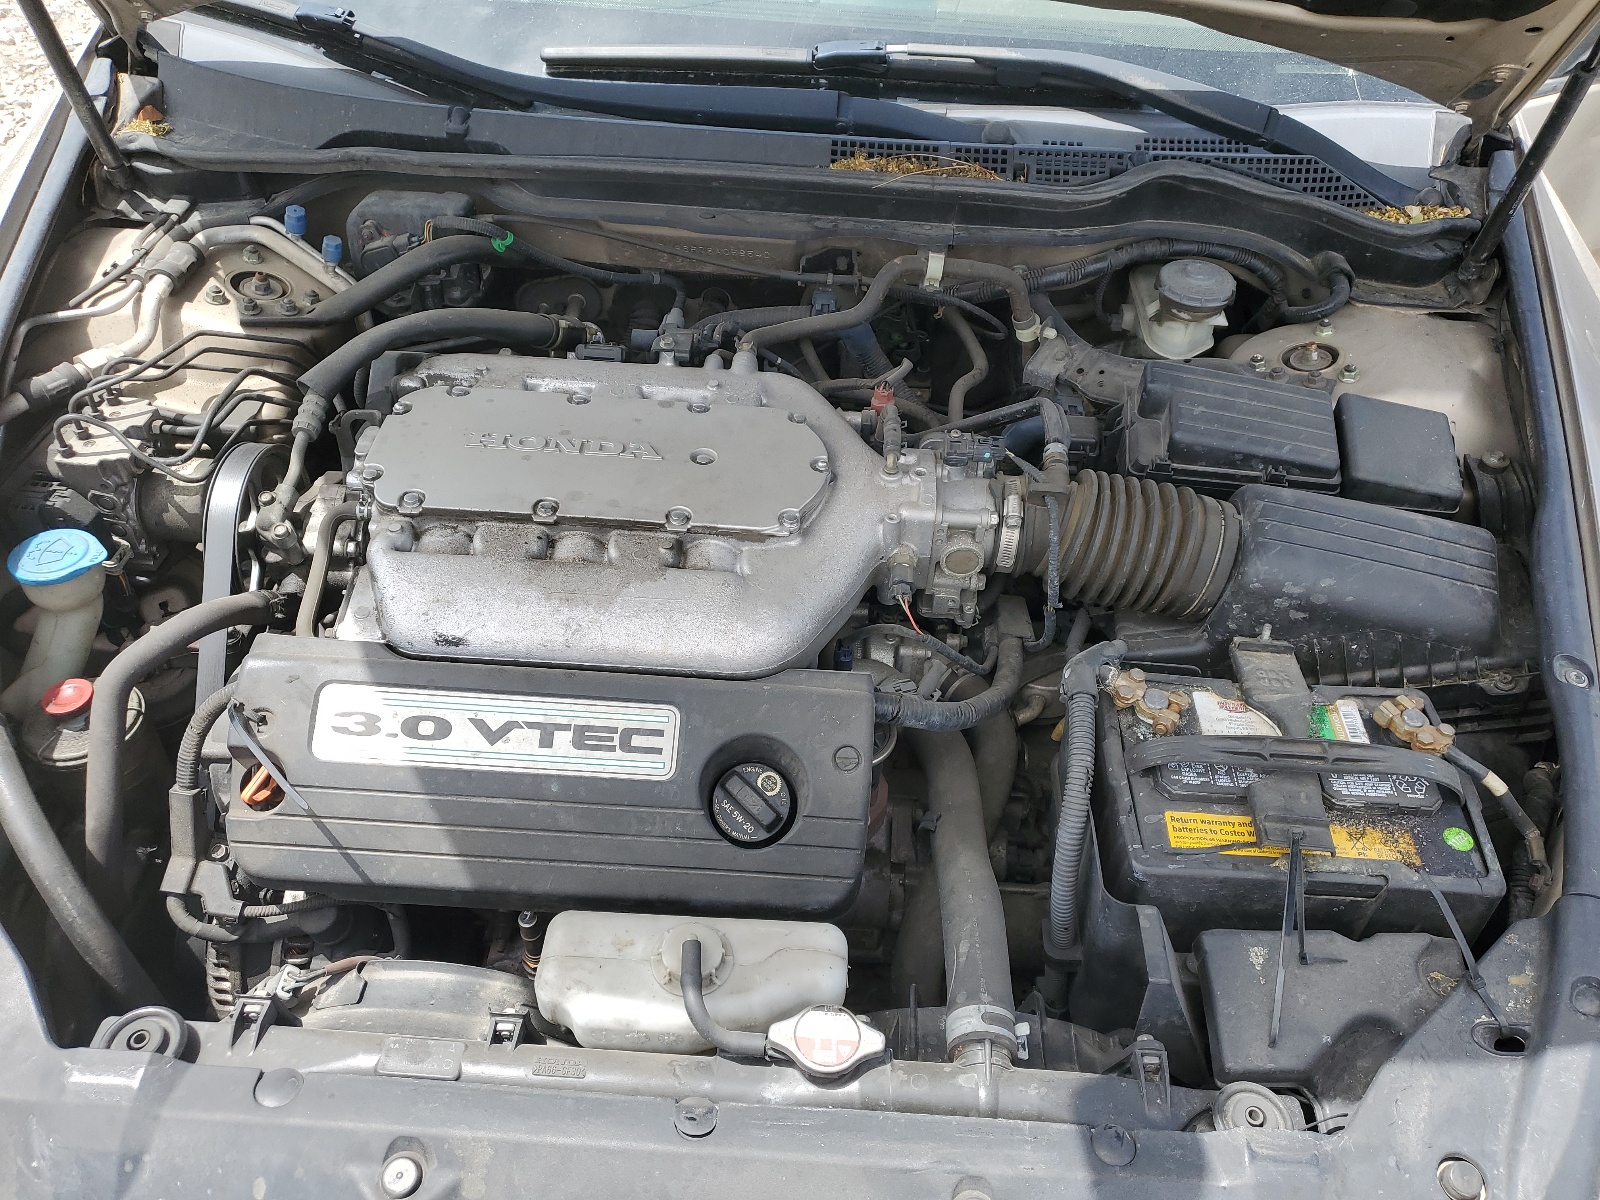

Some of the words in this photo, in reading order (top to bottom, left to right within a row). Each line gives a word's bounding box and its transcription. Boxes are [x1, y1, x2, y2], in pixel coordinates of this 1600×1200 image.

[464, 431, 664, 461] HONDA
[331, 711, 453, 741] 3.0
[466, 717, 665, 755] VTEC
[742, 766, 764, 774] ENGINE
[780, 792, 788, 806] OIL
[721, 799, 734, 814] SAE
[732, 810, 754, 833] 5W-20
[1170, 816, 1198, 824] Return
[1200, 819, 1235, 829] warranty
[1238, 820, 1253, 828] and
[1172, 825, 1208, 835] batteries
[1219, 828, 1246, 837] Costco
